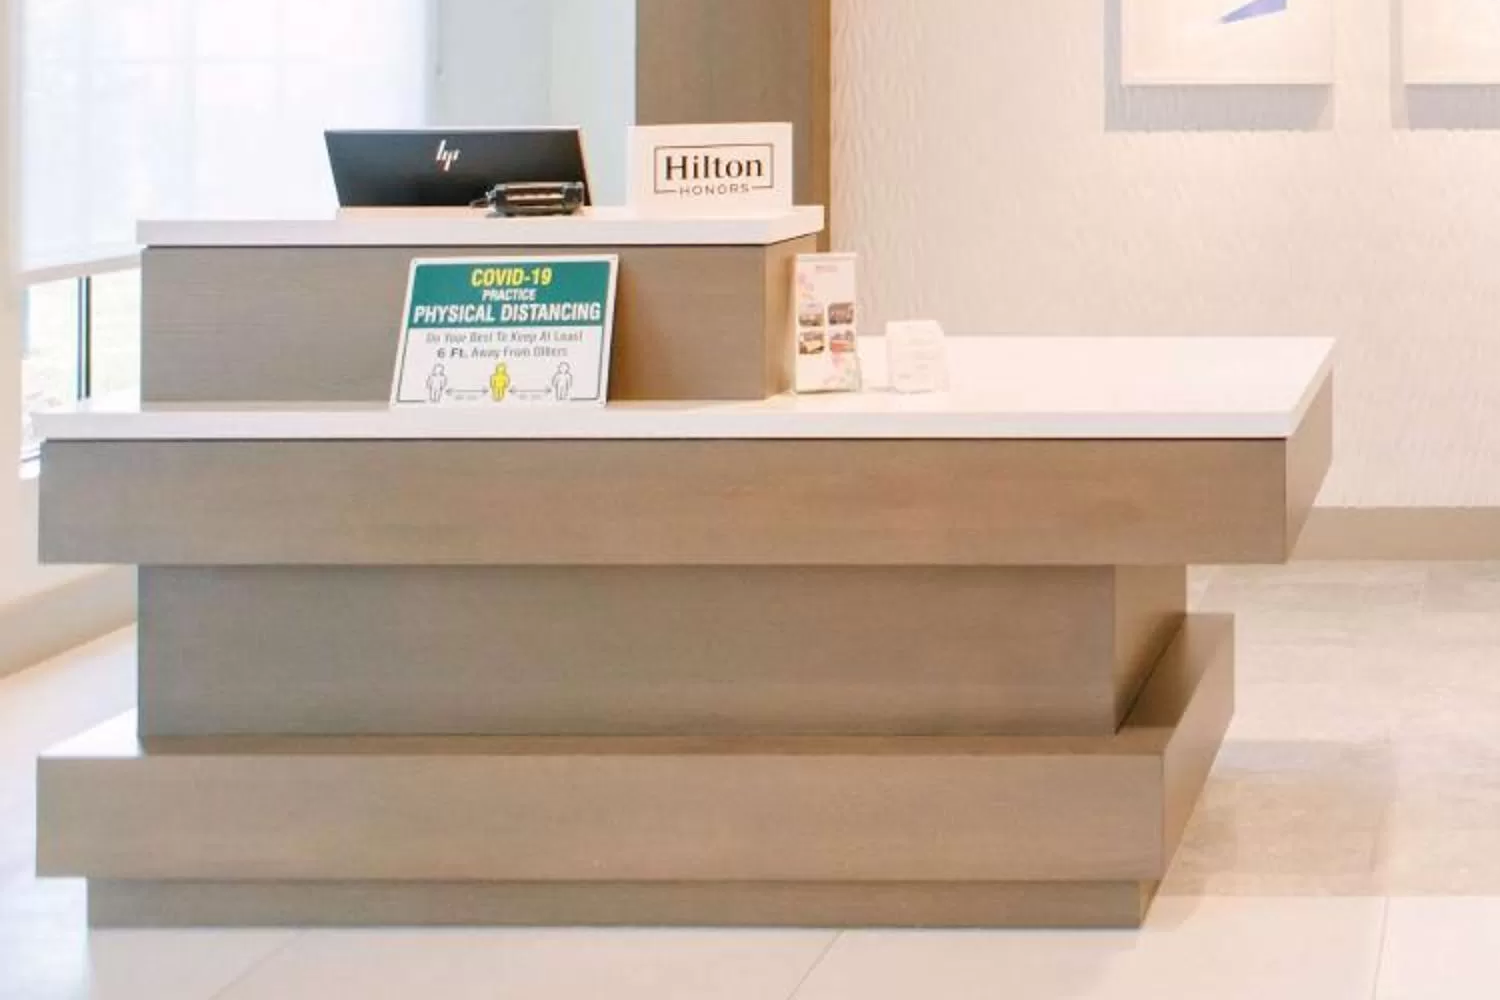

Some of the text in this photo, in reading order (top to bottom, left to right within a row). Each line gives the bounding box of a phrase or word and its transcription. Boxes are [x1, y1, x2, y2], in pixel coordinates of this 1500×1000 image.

[666, 154, 763, 180] Hilton
[680, 184, 750, 196] HONORS
[471, 268, 552, 286] COVID-19
[482, 288, 536, 301] PRACTICE
[413, 302, 601, 323] PHYSICAL DISTANCING
[511, 330, 537, 343] Keep
[437, 347, 446, 358] 6
[471, 347, 500, 359] Away
[503, 346, 531, 357] From
[533, 346, 568, 357] Others
